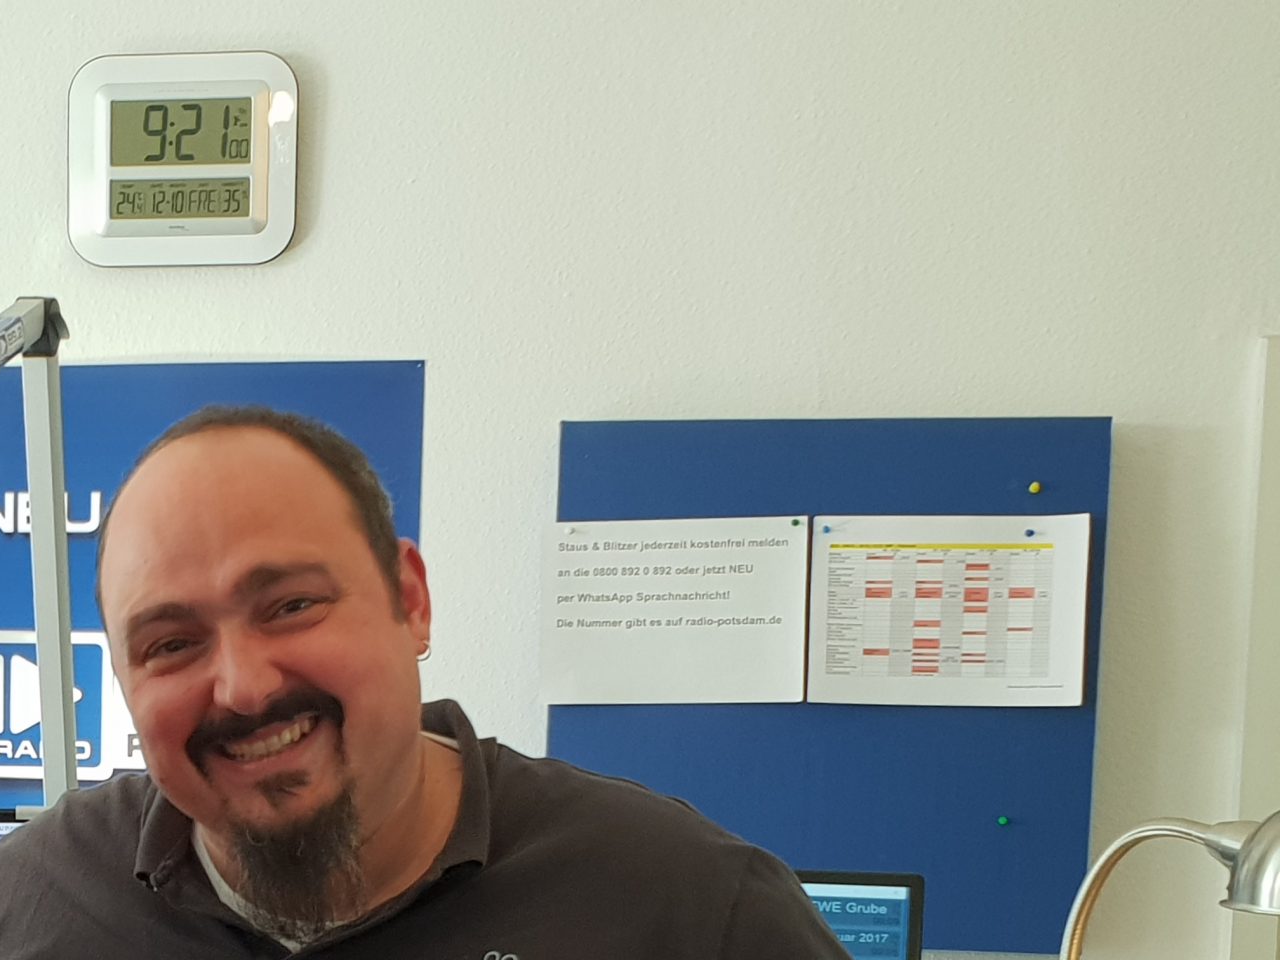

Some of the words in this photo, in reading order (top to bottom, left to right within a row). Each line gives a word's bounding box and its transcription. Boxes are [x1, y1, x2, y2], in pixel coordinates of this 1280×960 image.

[143, 104, 230, 161] 9:21
[558, 542, 589, 552] Staus
[592, 541, 600, 551] &
[603, 540, 638, 551] Blitzer
[639, 539, 687, 552] jederzeit
[690, 538, 745, 549] kostenfrei
[748, 538, 789, 548] melden
[557, 569, 571, 577] an
[573, 567, 591, 577] die
[593, 567, 618, 577] 0800
[621, 566, 641, 576] 892
[643, 566, 650, 576] 0
[652, 566, 672, 575] 892
[675, 565, 700, 576] oder
[702, 565, 726, 577] jetzt
[729, 564, 754, 574] NEU
[557, 594, 575, 604] per
[577, 593, 633, 604] WhatsApp
[635, 590, 731, 603] Sprachnachricht!
[556, 618, 574, 628] Die
[576, 618, 623, 628] Nummer
[625, 617, 647, 629] gibt
[649, 619, 662, 628] es
[665, 616, 683, 627] auf
[685, 615, 782, 628] radio-potsdam.de
[846, 902, 888, 914] Grube
[858, 933, 889, 943] 2017
